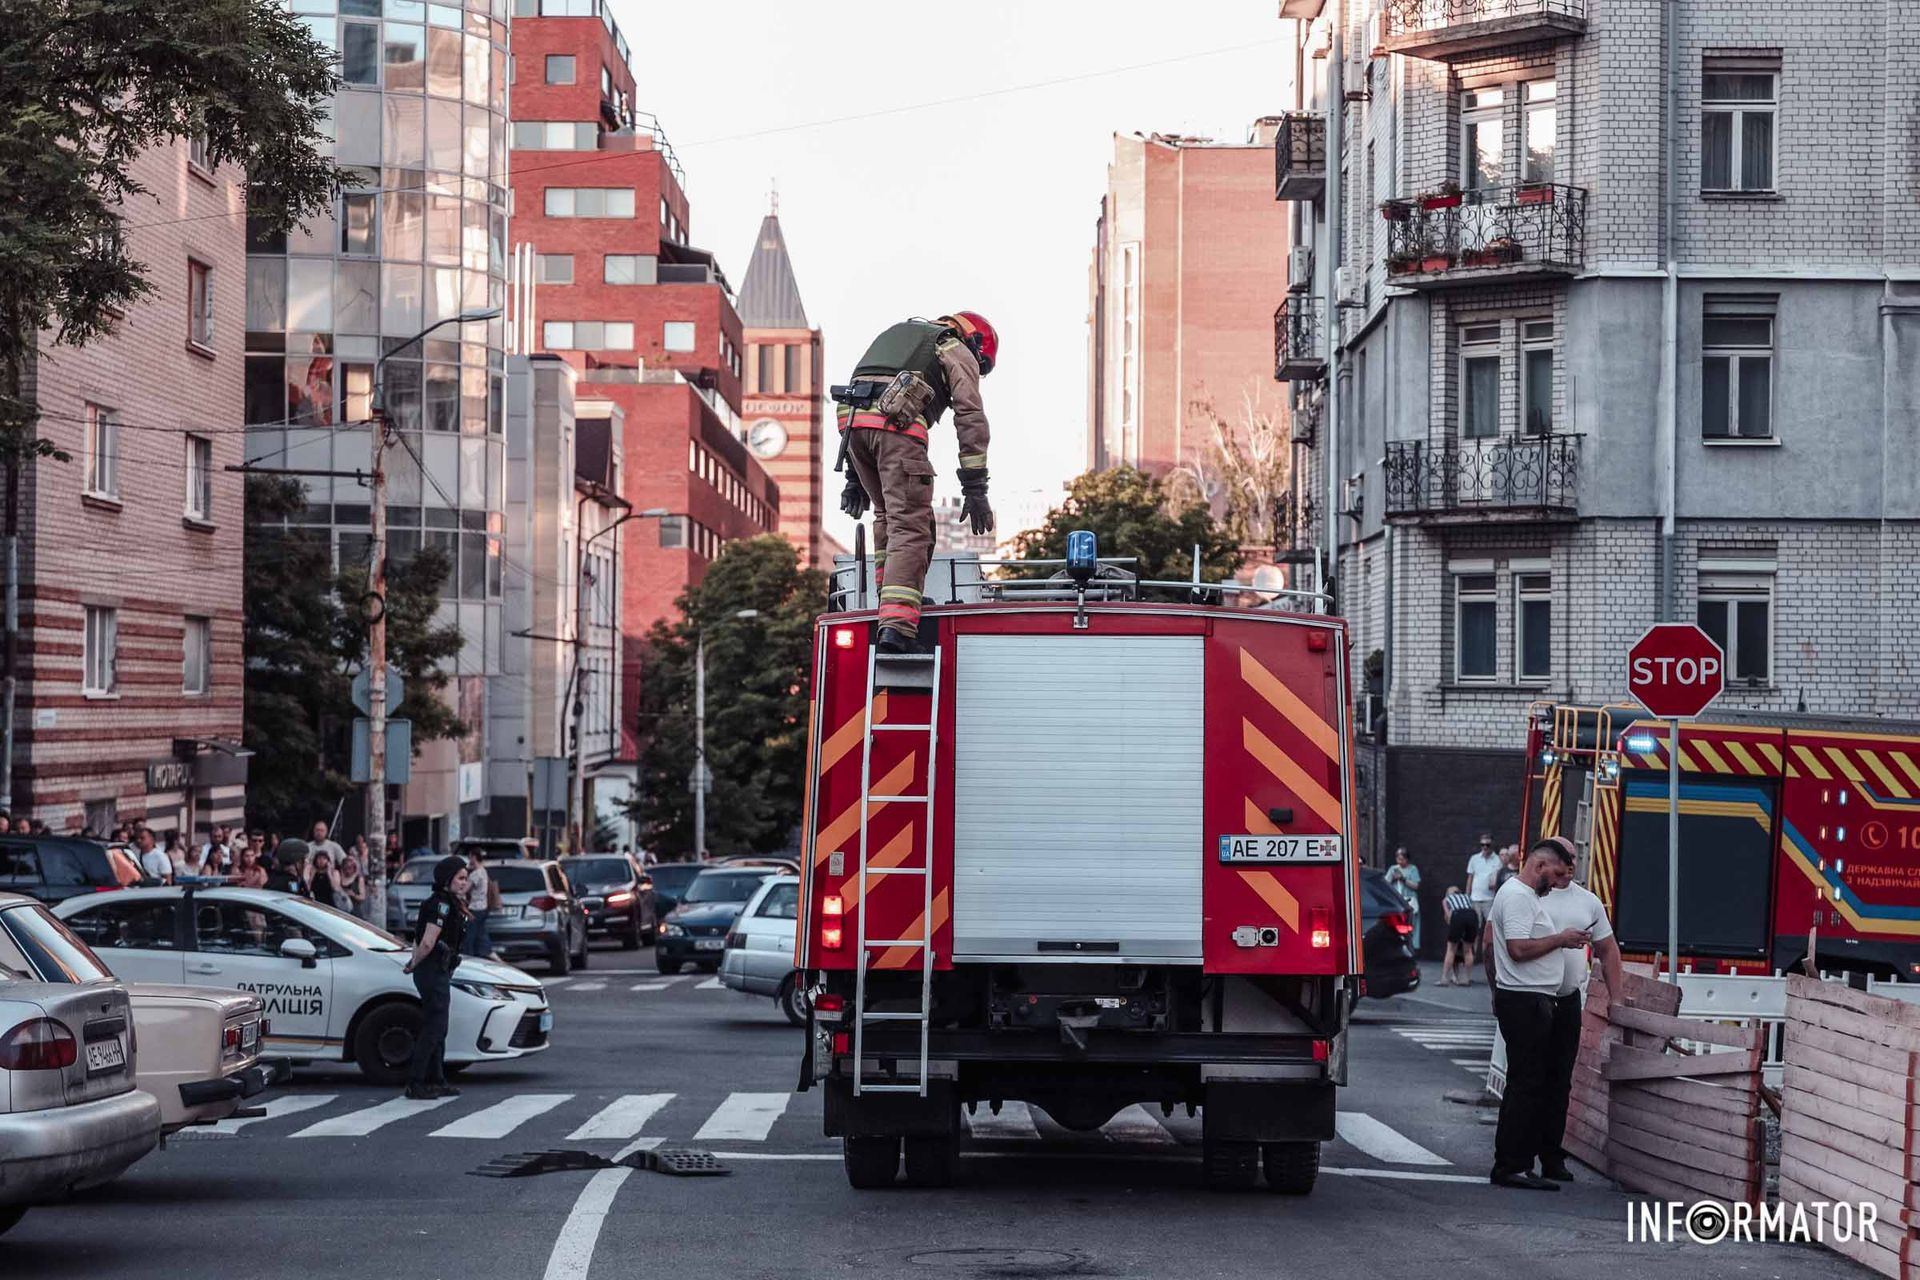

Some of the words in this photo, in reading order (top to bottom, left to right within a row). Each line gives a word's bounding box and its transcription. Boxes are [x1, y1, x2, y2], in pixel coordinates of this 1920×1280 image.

[1632, 657, 1719, 685] STOP
[1232, 840, 1259, 857] AE
[1266, 840, 1299, 857] 207
[1306, 840, 1319, 857] E
[1846, 864, 1905, 876] ДЕРЖАВНА
[237, 982, 322, 997] ПАТРУЛЬНА
